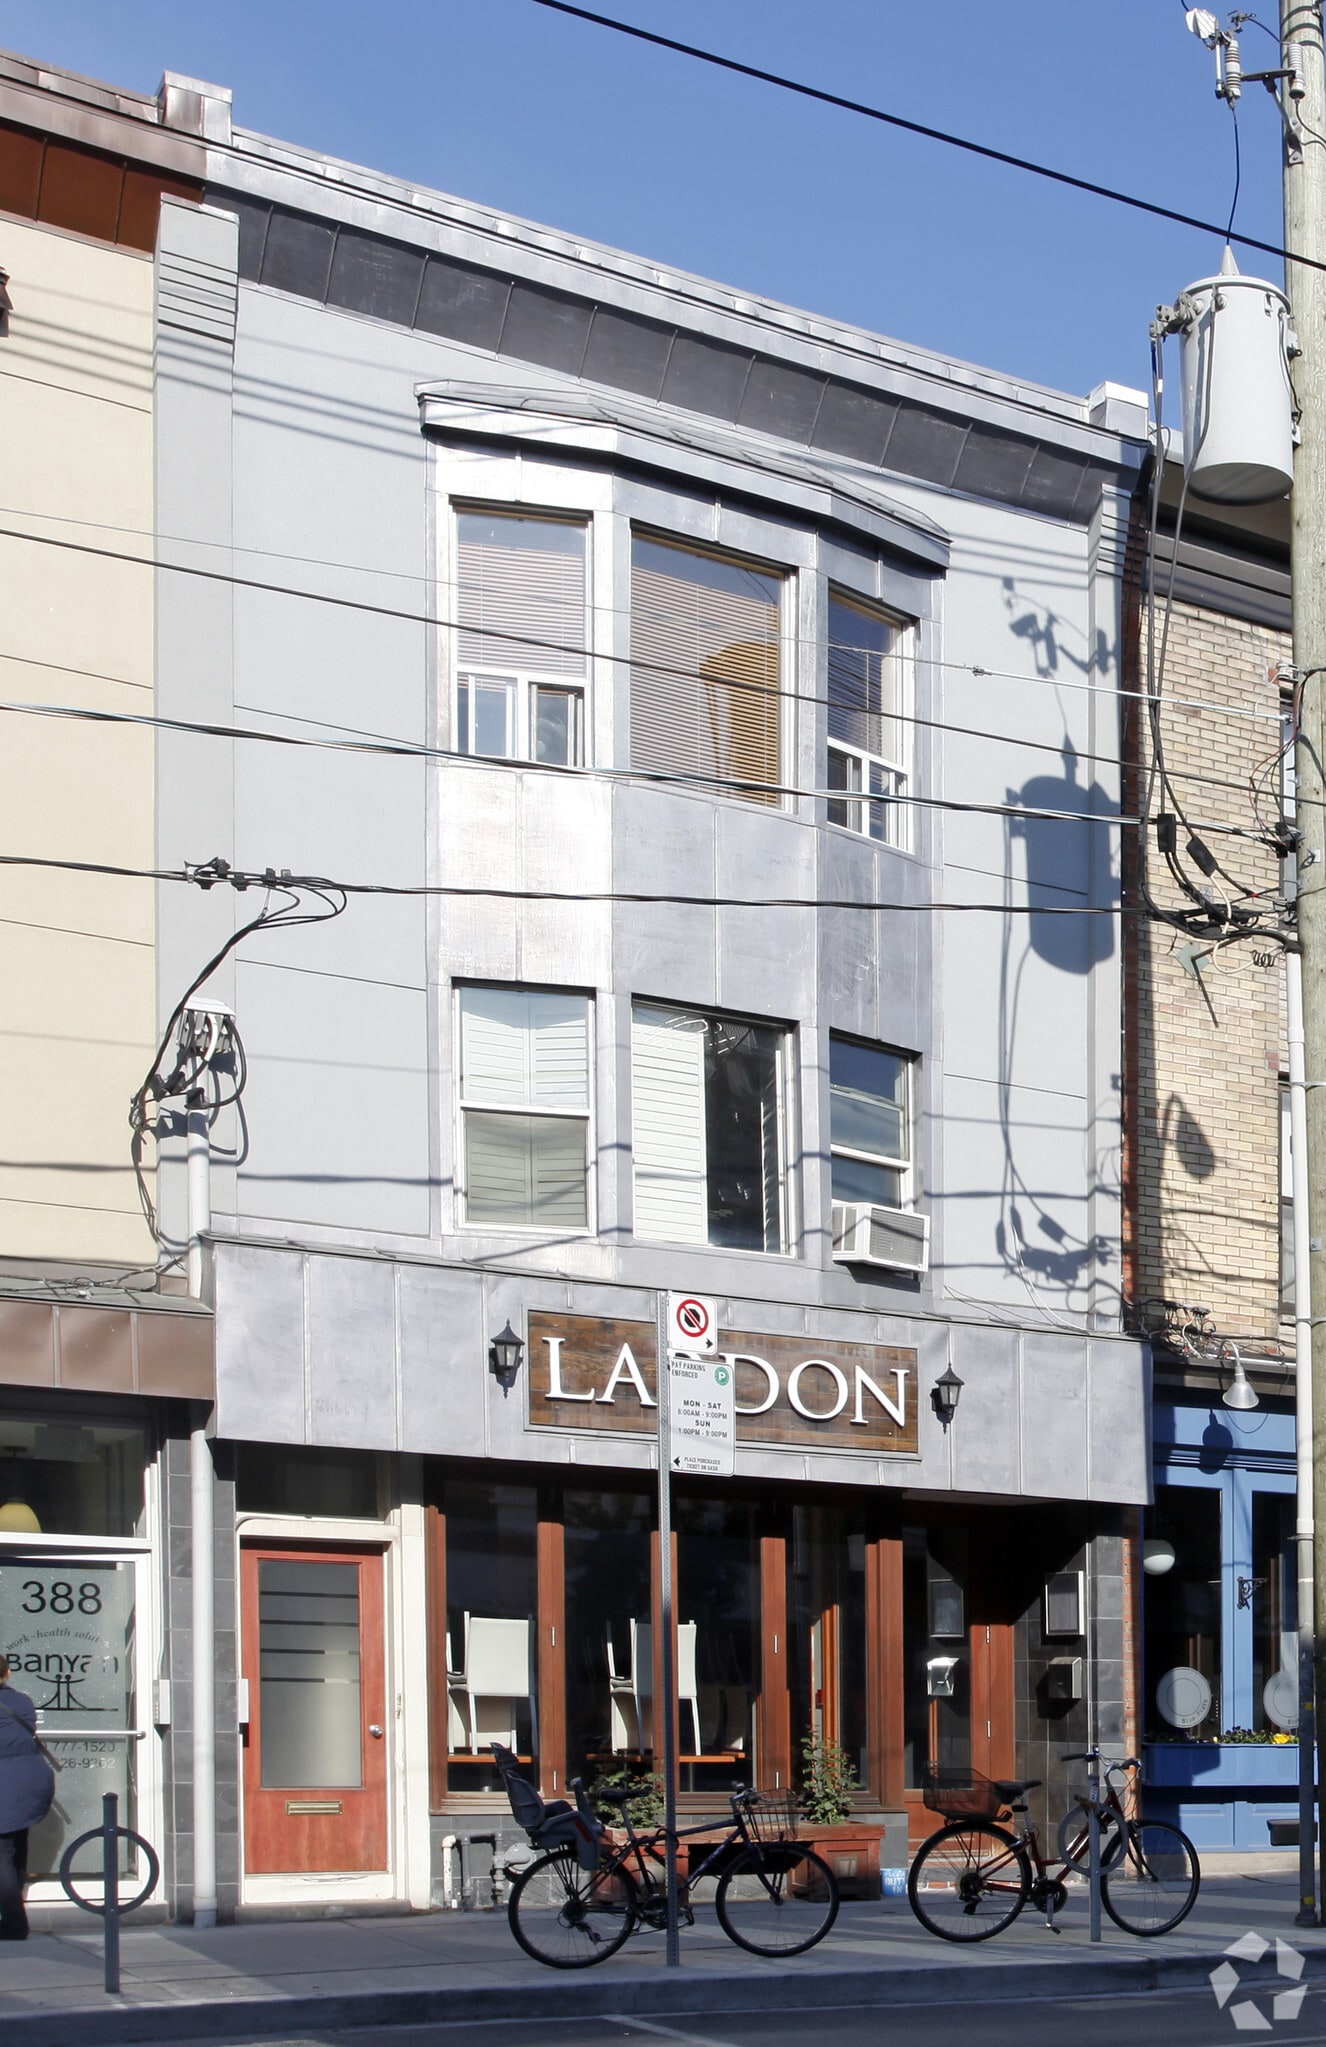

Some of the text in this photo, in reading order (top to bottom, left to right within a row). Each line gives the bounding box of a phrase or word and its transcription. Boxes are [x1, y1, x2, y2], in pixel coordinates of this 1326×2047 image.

[671, 1361, 706, 1372] PAY PARKING
[672, 1370, 699, 1378] ENFORCED
[541, 1336, 910, 1427] LADON
[683, 1400, 701, 1408] MON
[707, 1402, 722, 1410] SAT
[677, 1409, 701, 1417] 8:00AM
[705, 1411, 728, 1419] 9:00PM
[695, 1420, 711, 1428] SUN
[678, 1428, 701, 1436] 1:00PM
[705, 1430, 728, 1438] 9:00PM
[22, 1580, 102, 1615] 388
[53, 1741, 116, 1752] 777-1520
[57, 1758, 116, 1769] 26-9262
